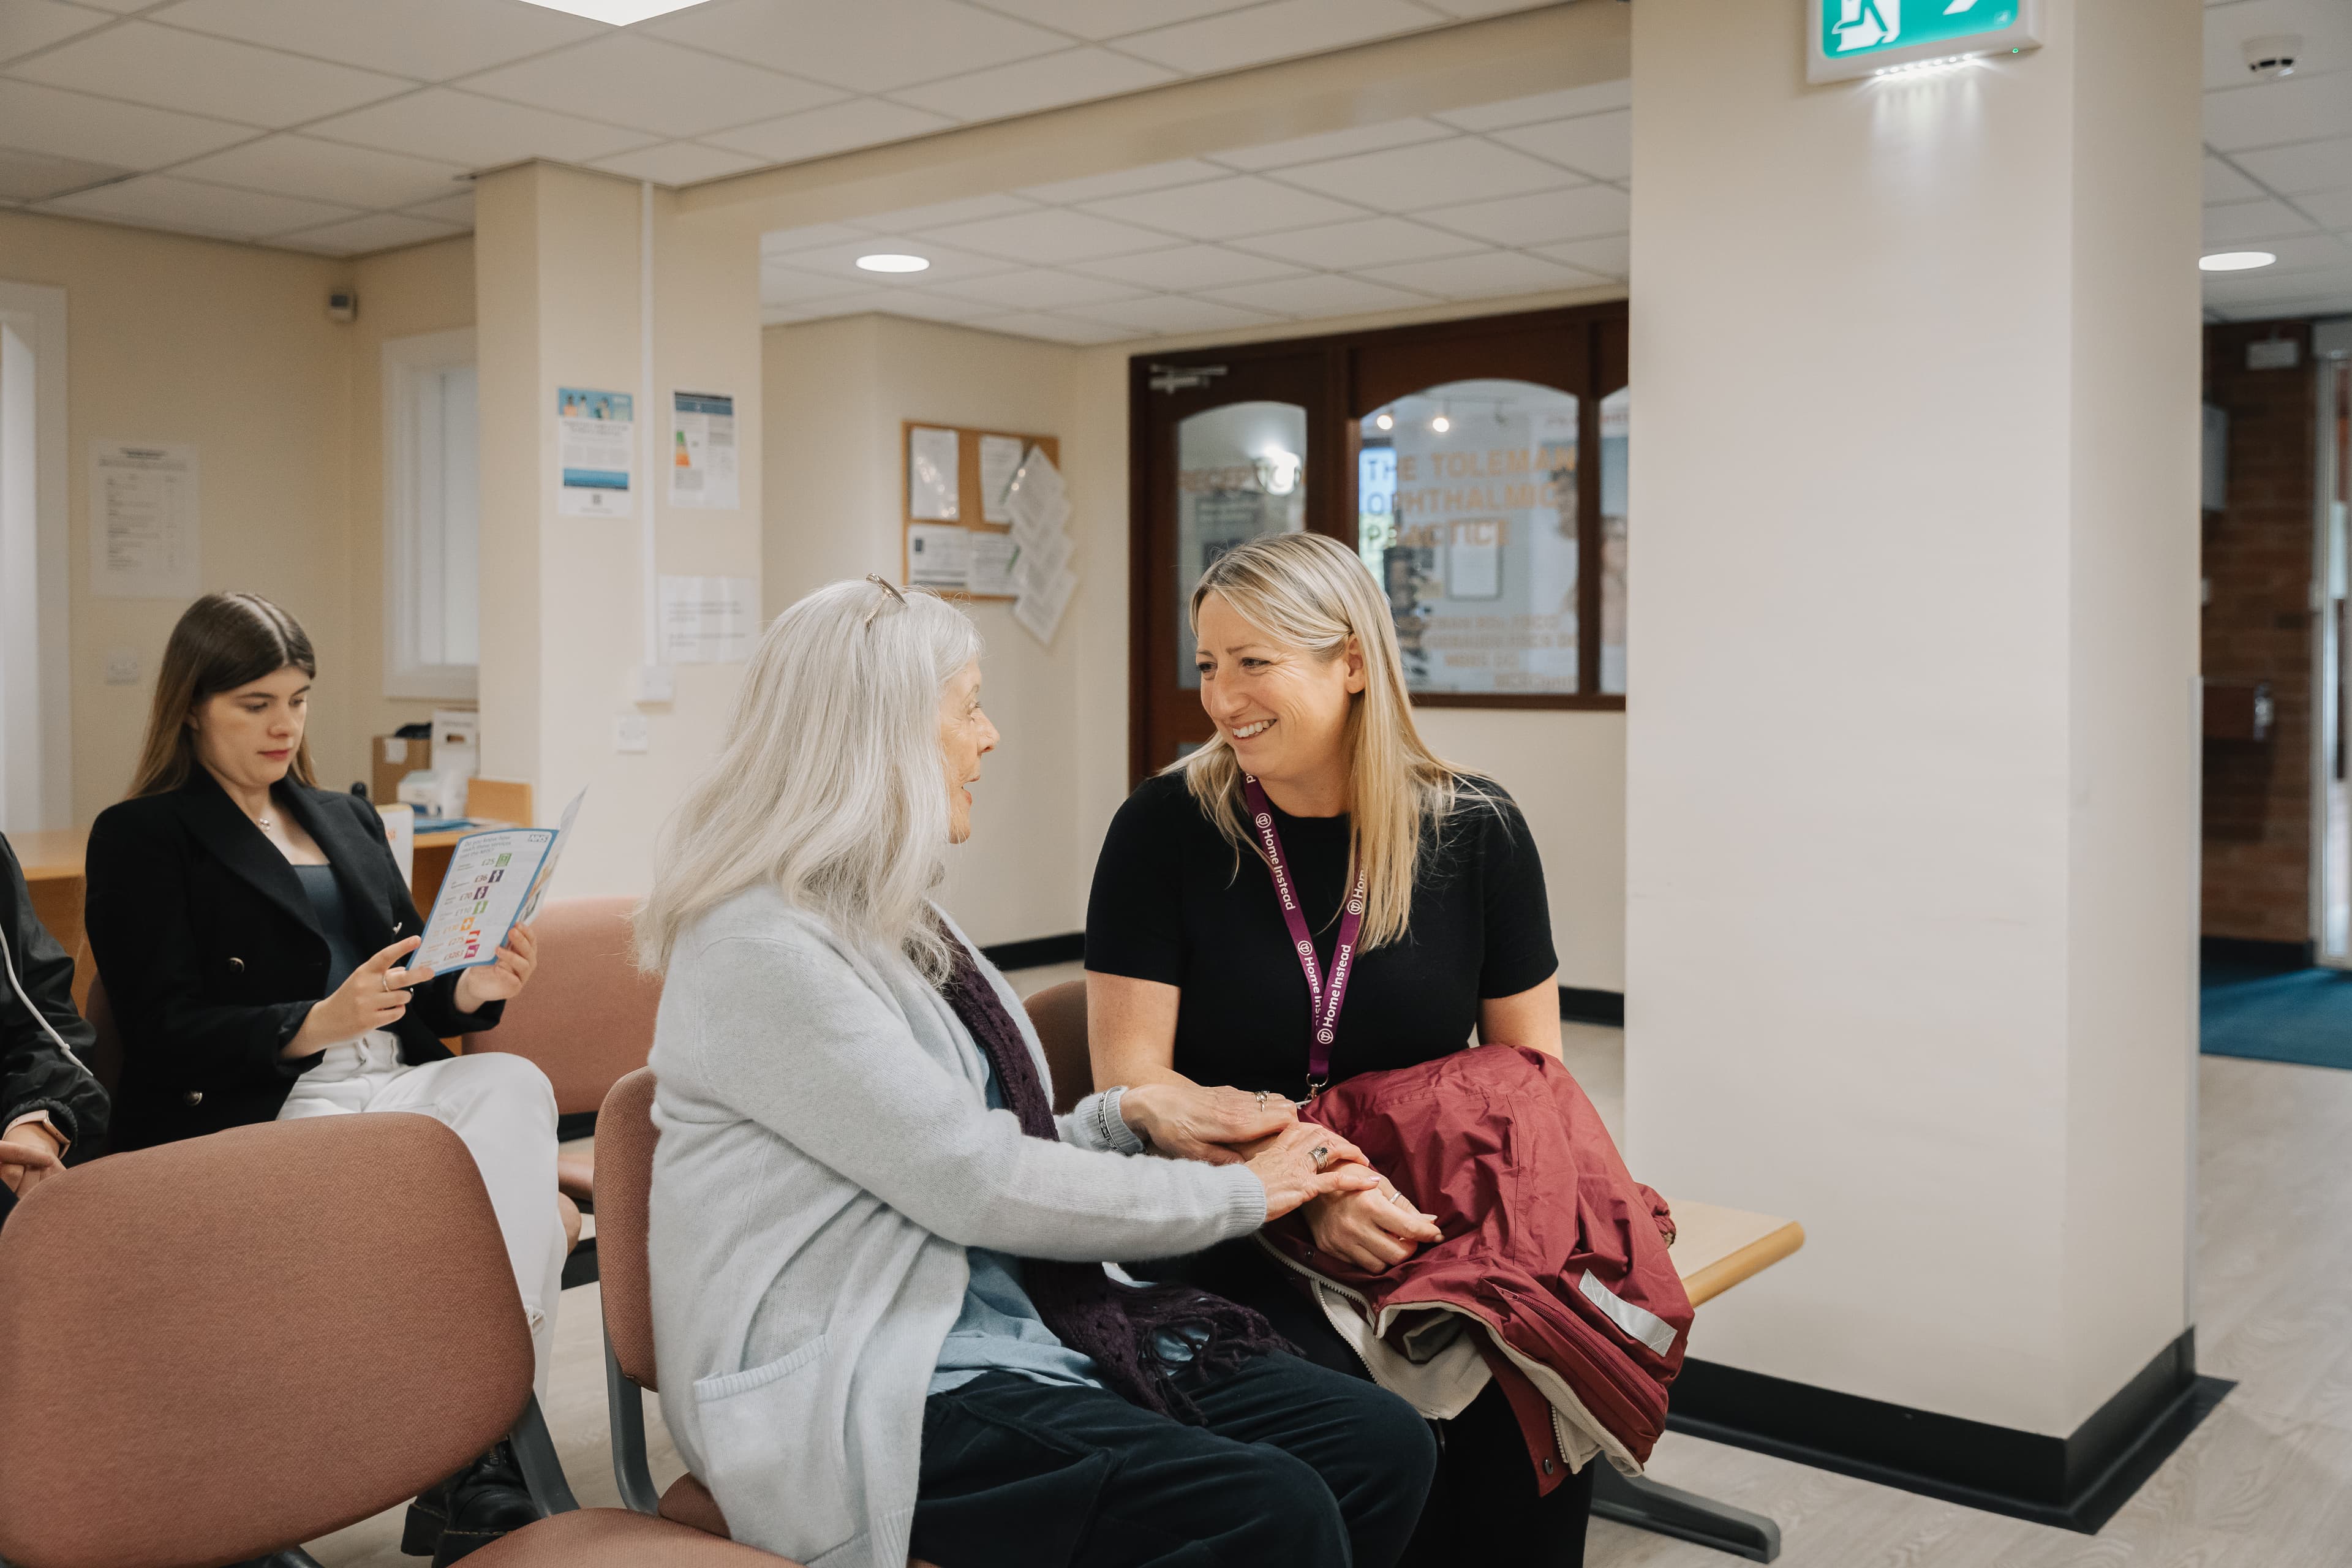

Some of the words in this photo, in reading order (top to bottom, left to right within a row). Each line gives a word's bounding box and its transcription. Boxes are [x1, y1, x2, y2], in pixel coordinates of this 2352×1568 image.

[1368, 456, 1416, 481] THE
[1431, 445, 1577, 479] TOLEMAN
[528, 834, 548, 843] NHS
[481, 858, 495, 867] £25
[1262, 828, 1280, 865] Home
[1273, 865, 1296, 911] Instead
[475, 874, 488, 883] £36
[1352, 869, 1365, 899] Hom
[460, 892, 473, 901] £70
[1304, 956, 1320, 993] Home
[1322, 990, 1340, 1027] Home
[1331, 944, 1352, 989] Instead
